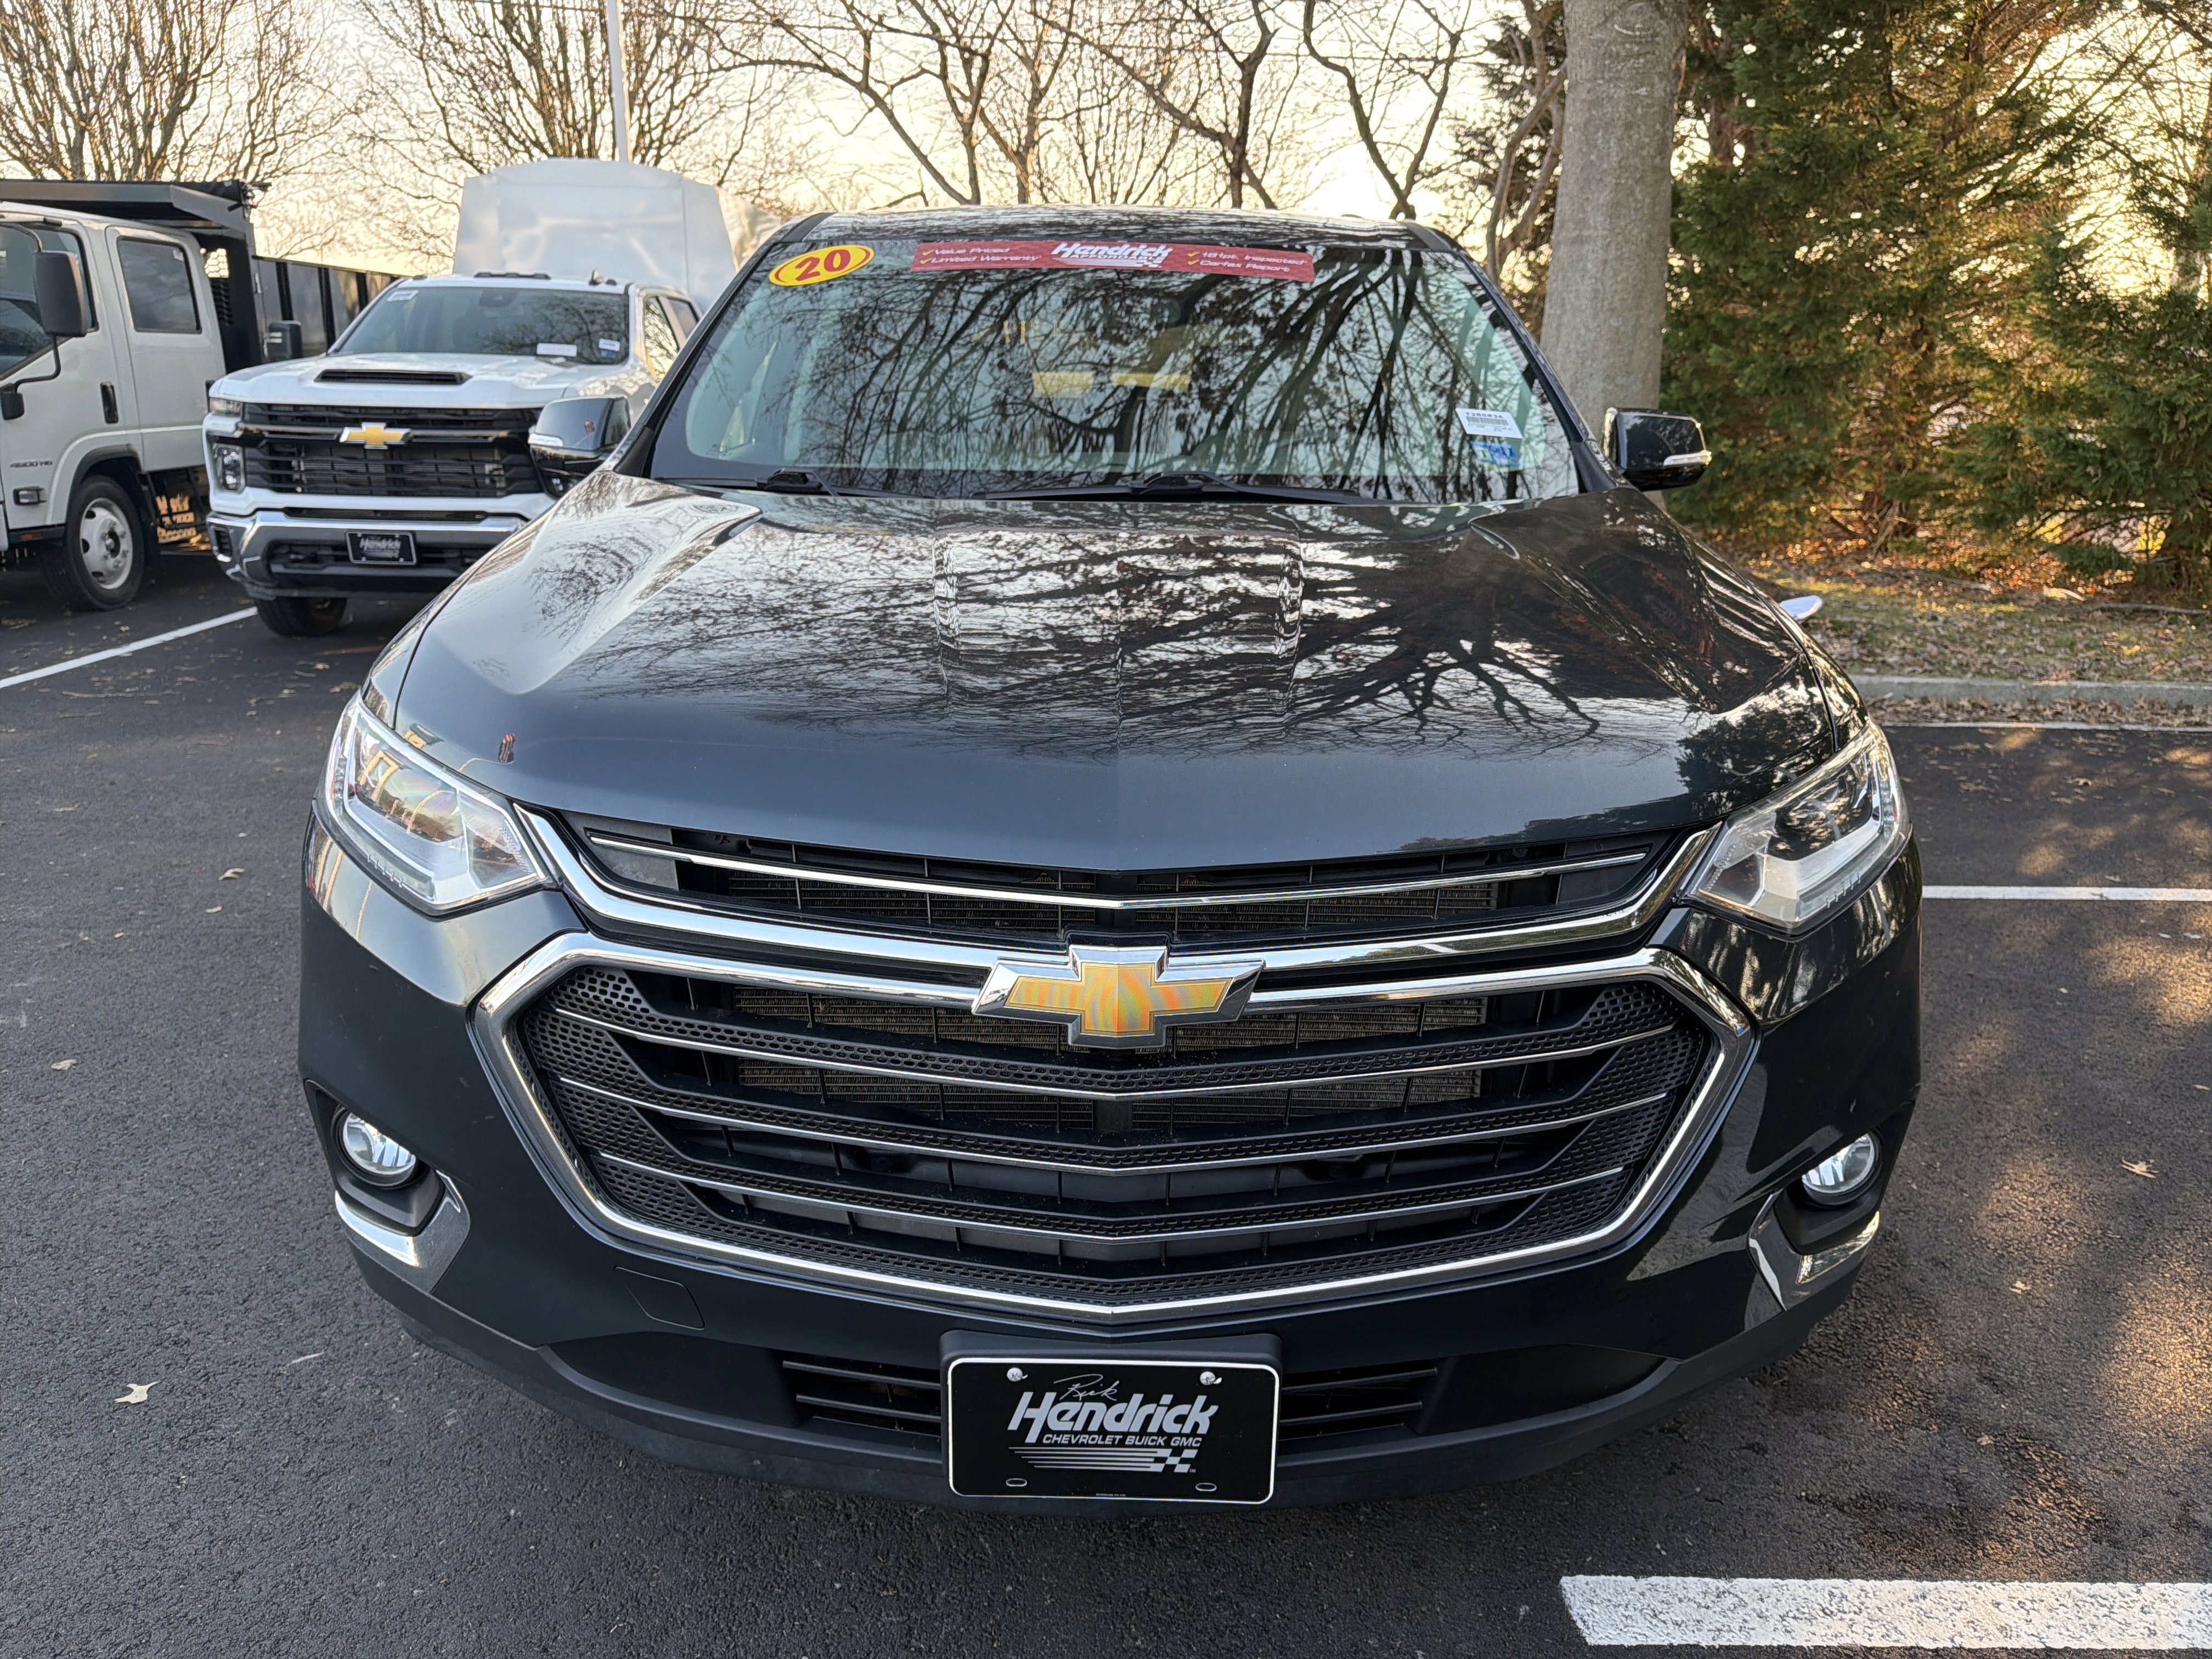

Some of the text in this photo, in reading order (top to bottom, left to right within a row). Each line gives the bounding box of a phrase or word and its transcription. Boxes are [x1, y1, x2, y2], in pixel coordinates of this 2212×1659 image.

[1051, 242, 1173, 258] Hendrick
[795, 250, 850, 281] 20
[1245, 263, 1290, 272] Report
[1053, 1374, 1120, 1401] Rick
[1007, 1392, 1218, 1443] Hendrick
[1042, 1434, 1202, 1447] CHEVROLET BUICK GMC
